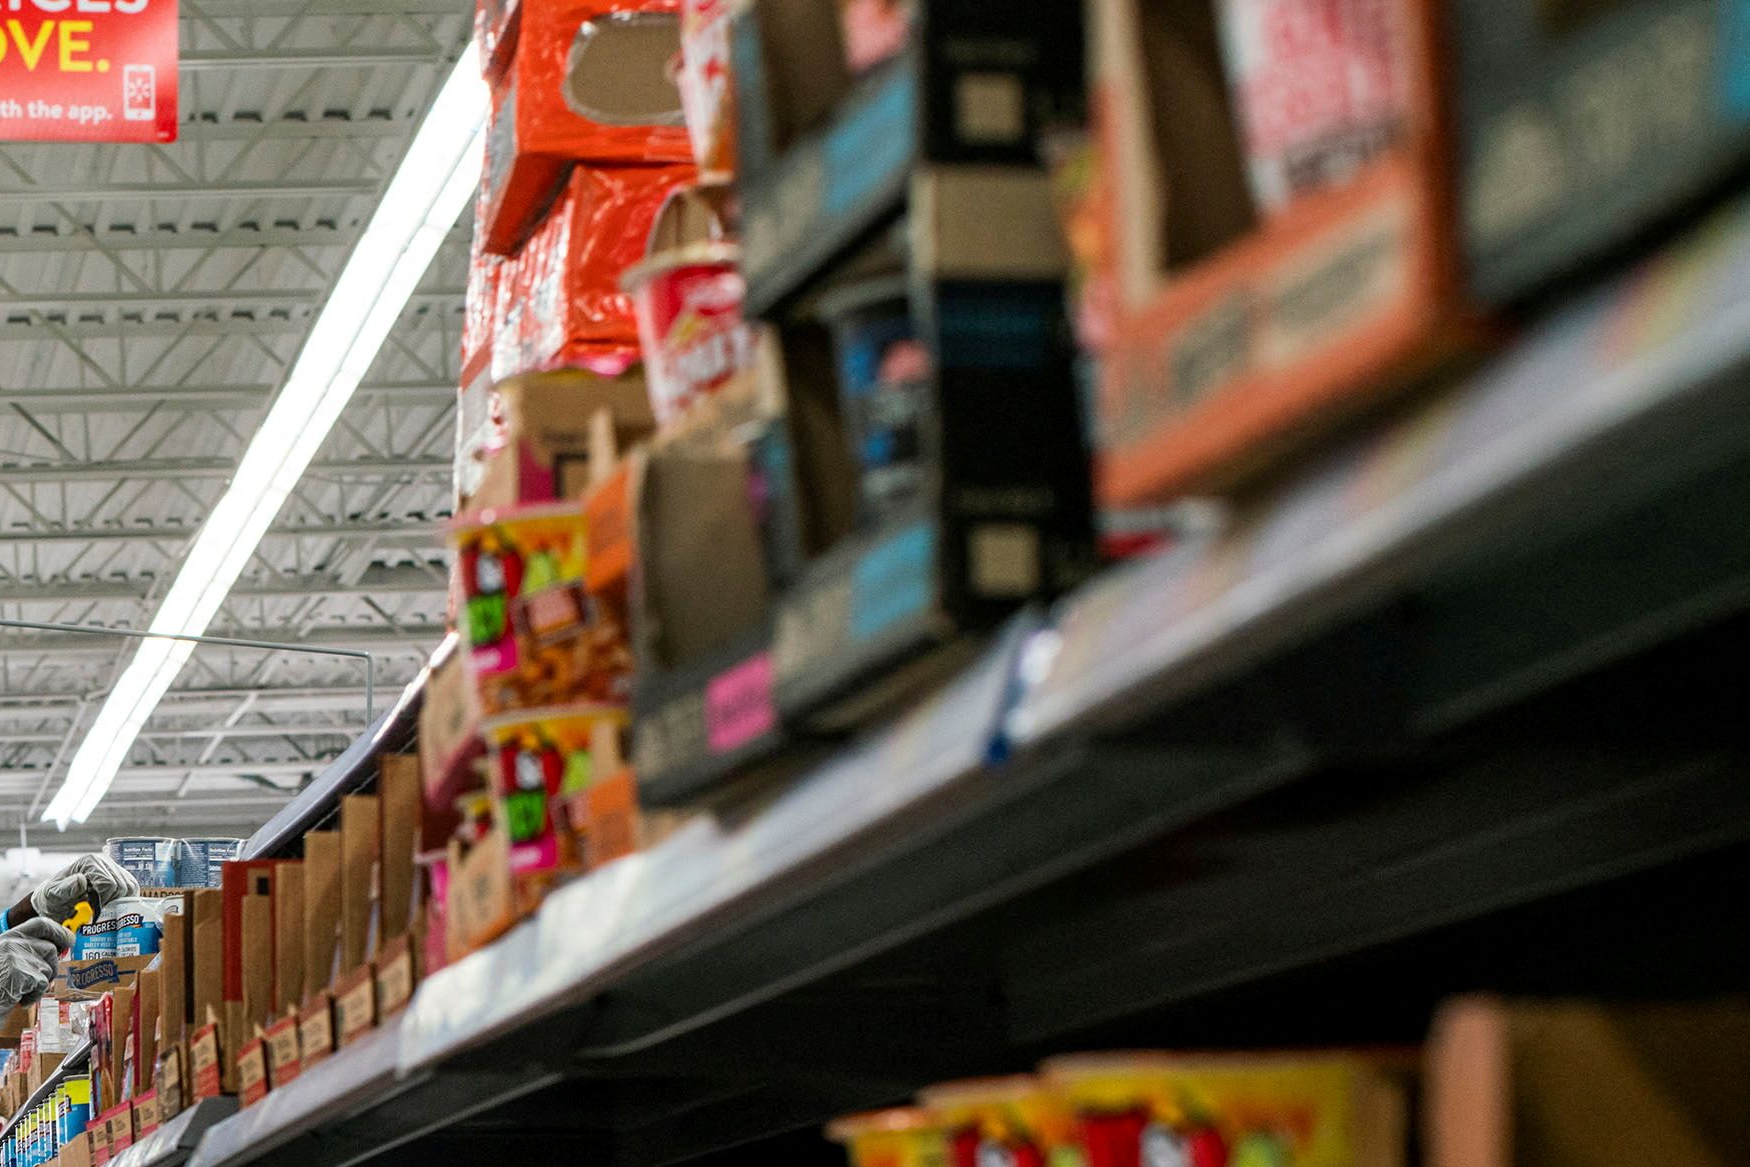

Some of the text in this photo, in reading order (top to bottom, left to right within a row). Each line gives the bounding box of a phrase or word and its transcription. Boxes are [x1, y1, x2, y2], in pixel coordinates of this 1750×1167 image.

[26, 101, 63, 120] the
[67, 106, 112, 125] app.
[72, 963, 114, 986] PROGRESSO
